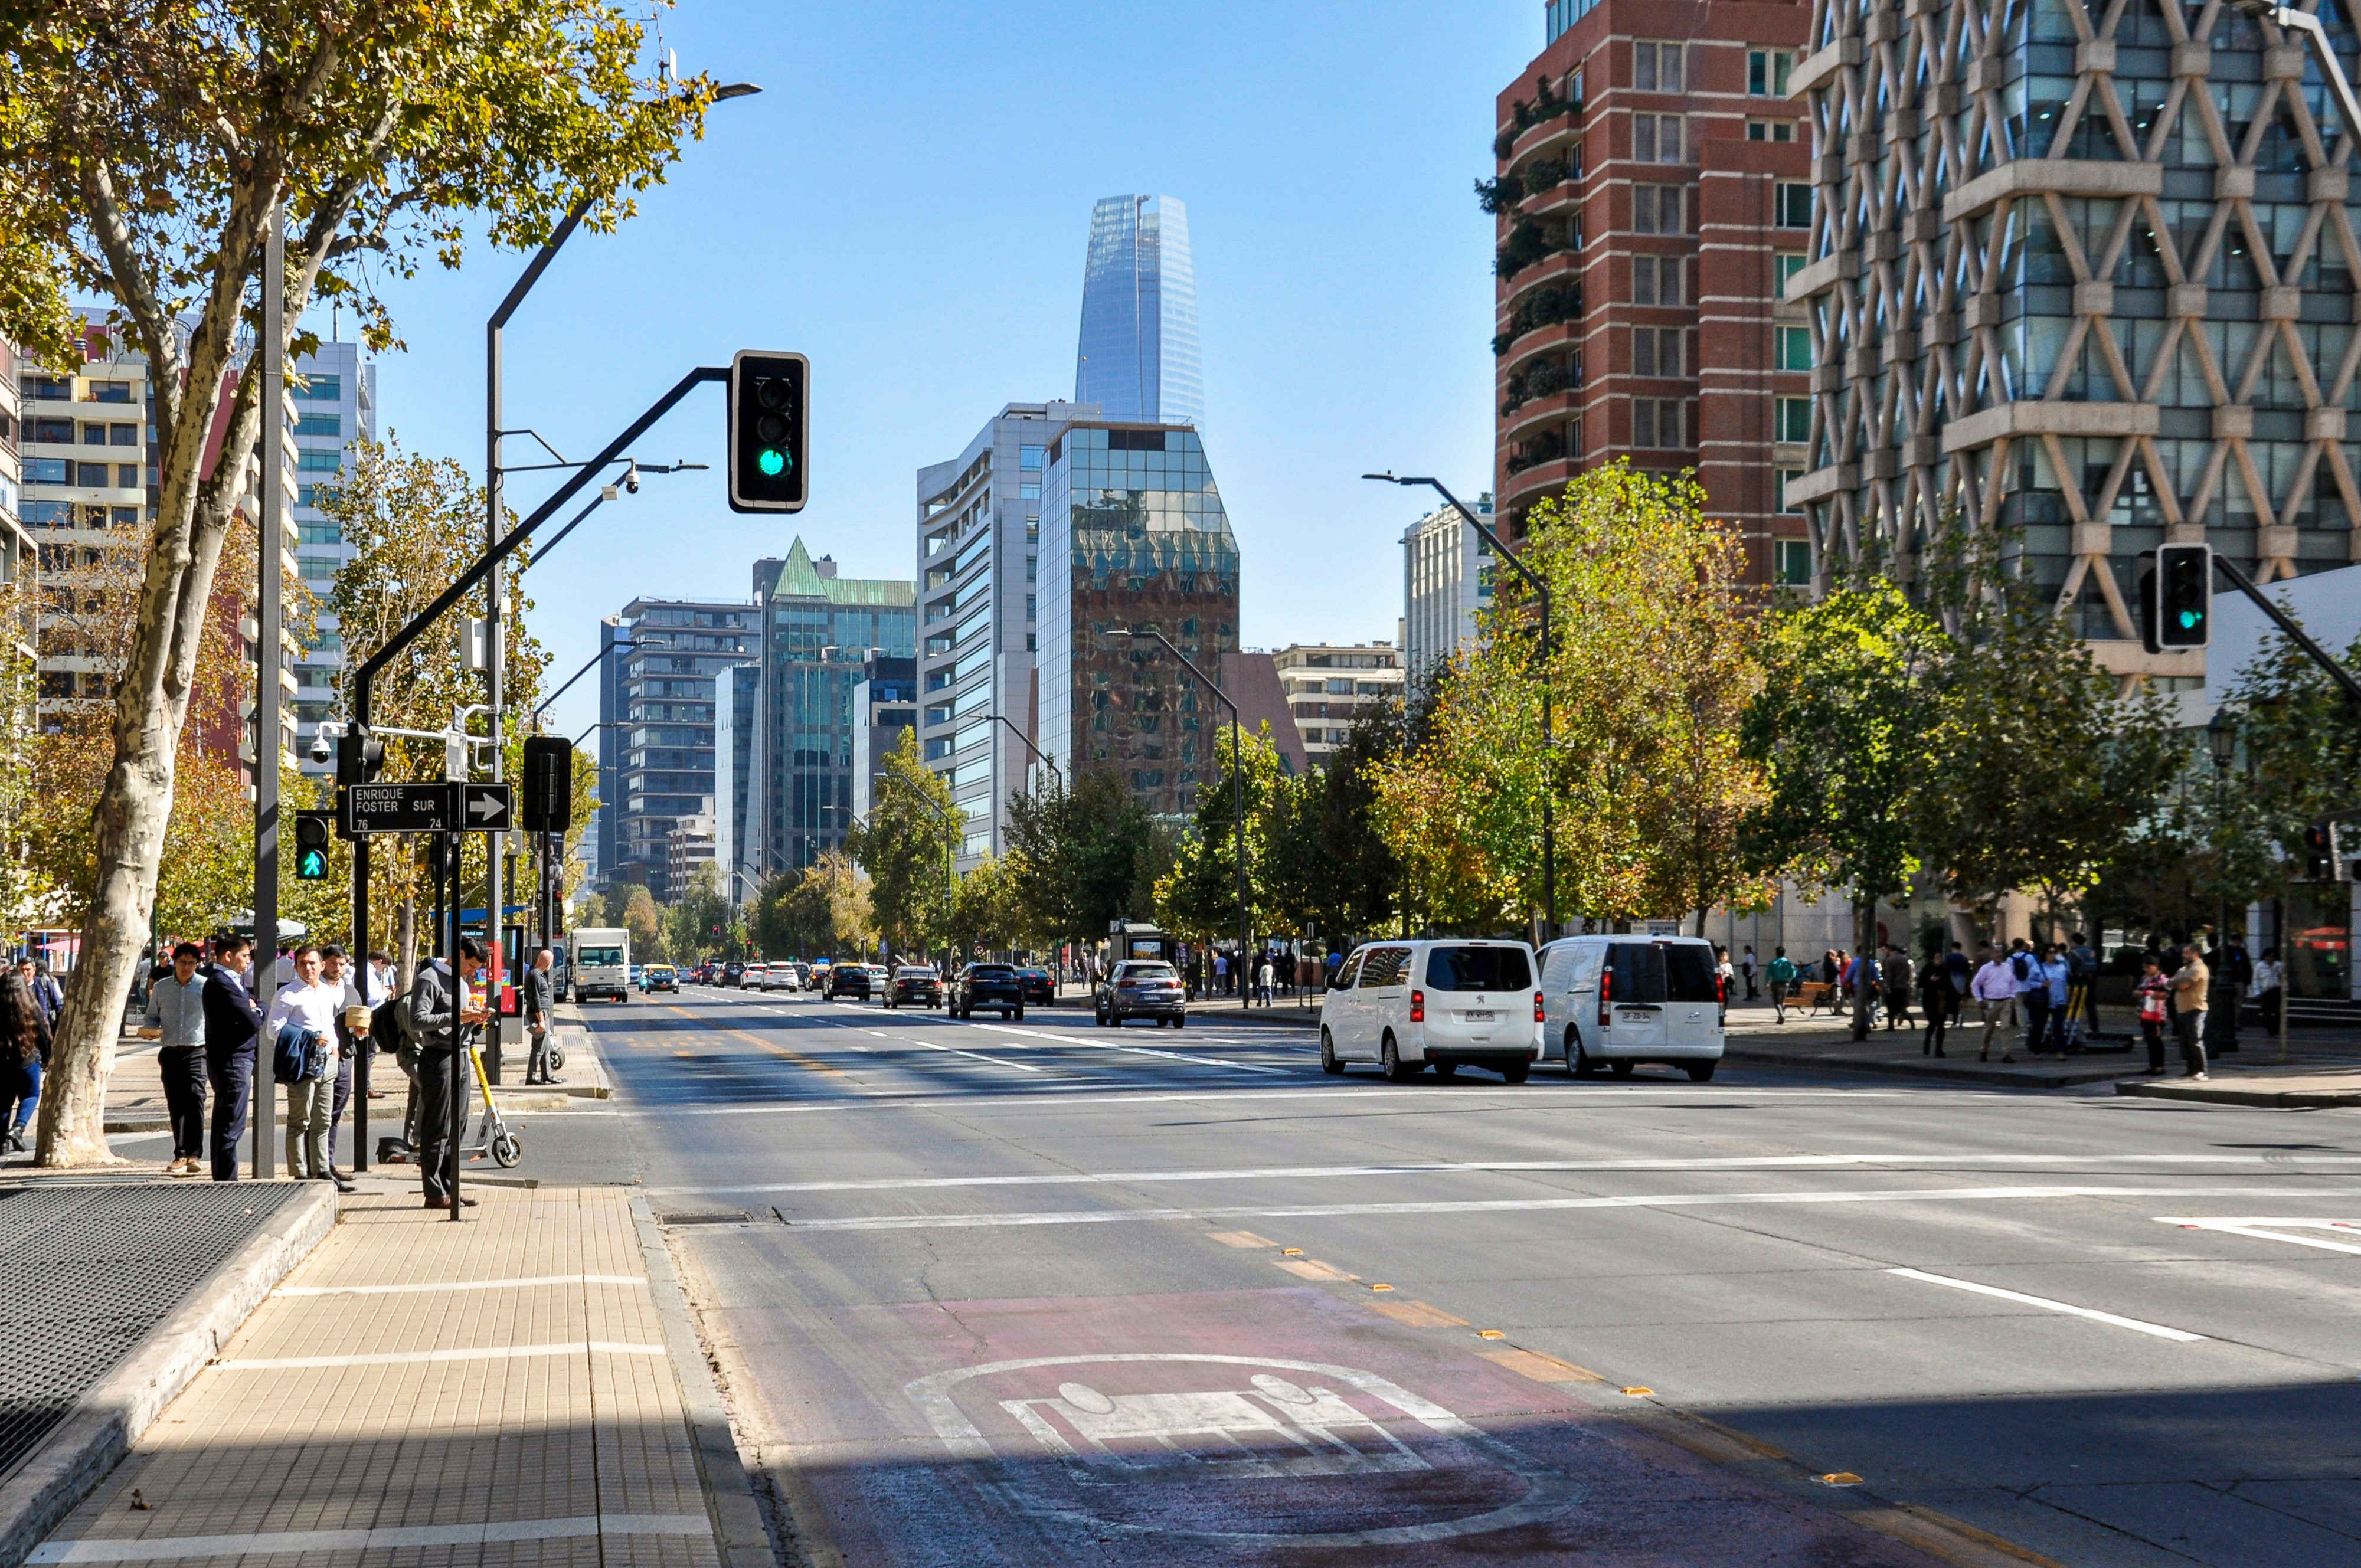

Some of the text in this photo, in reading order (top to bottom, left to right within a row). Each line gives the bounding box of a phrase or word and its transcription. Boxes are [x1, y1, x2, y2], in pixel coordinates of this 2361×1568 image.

[356, 788, 404, 800] ENRIQUE
[356, 800, 435, 813] FOSTER SUR
[357, 818, 442, 830] 76 24
